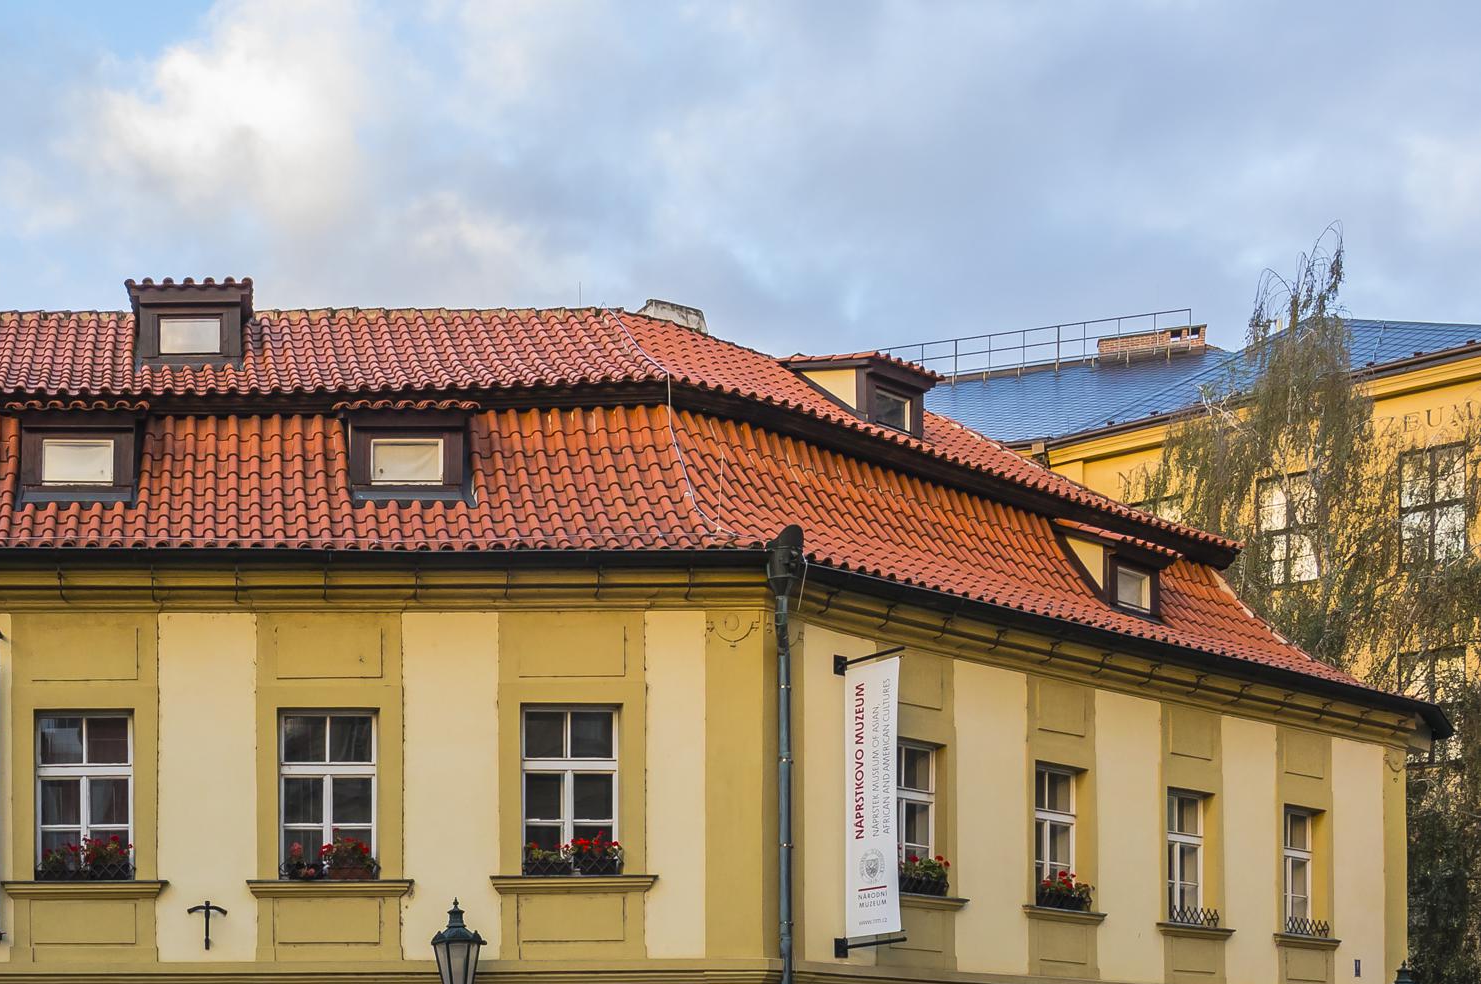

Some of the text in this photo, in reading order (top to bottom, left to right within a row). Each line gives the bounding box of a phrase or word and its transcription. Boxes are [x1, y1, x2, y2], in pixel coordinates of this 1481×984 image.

[882, 678, 890, 721] CULTURES
[854, 683, 865, 839] NÁPRSTKOVO MUZEUM
[872, 736, 880, 748] OF
[872, 750, 880, 792] MUSEUM
[859, 899, 887, 908] MUZEUM
